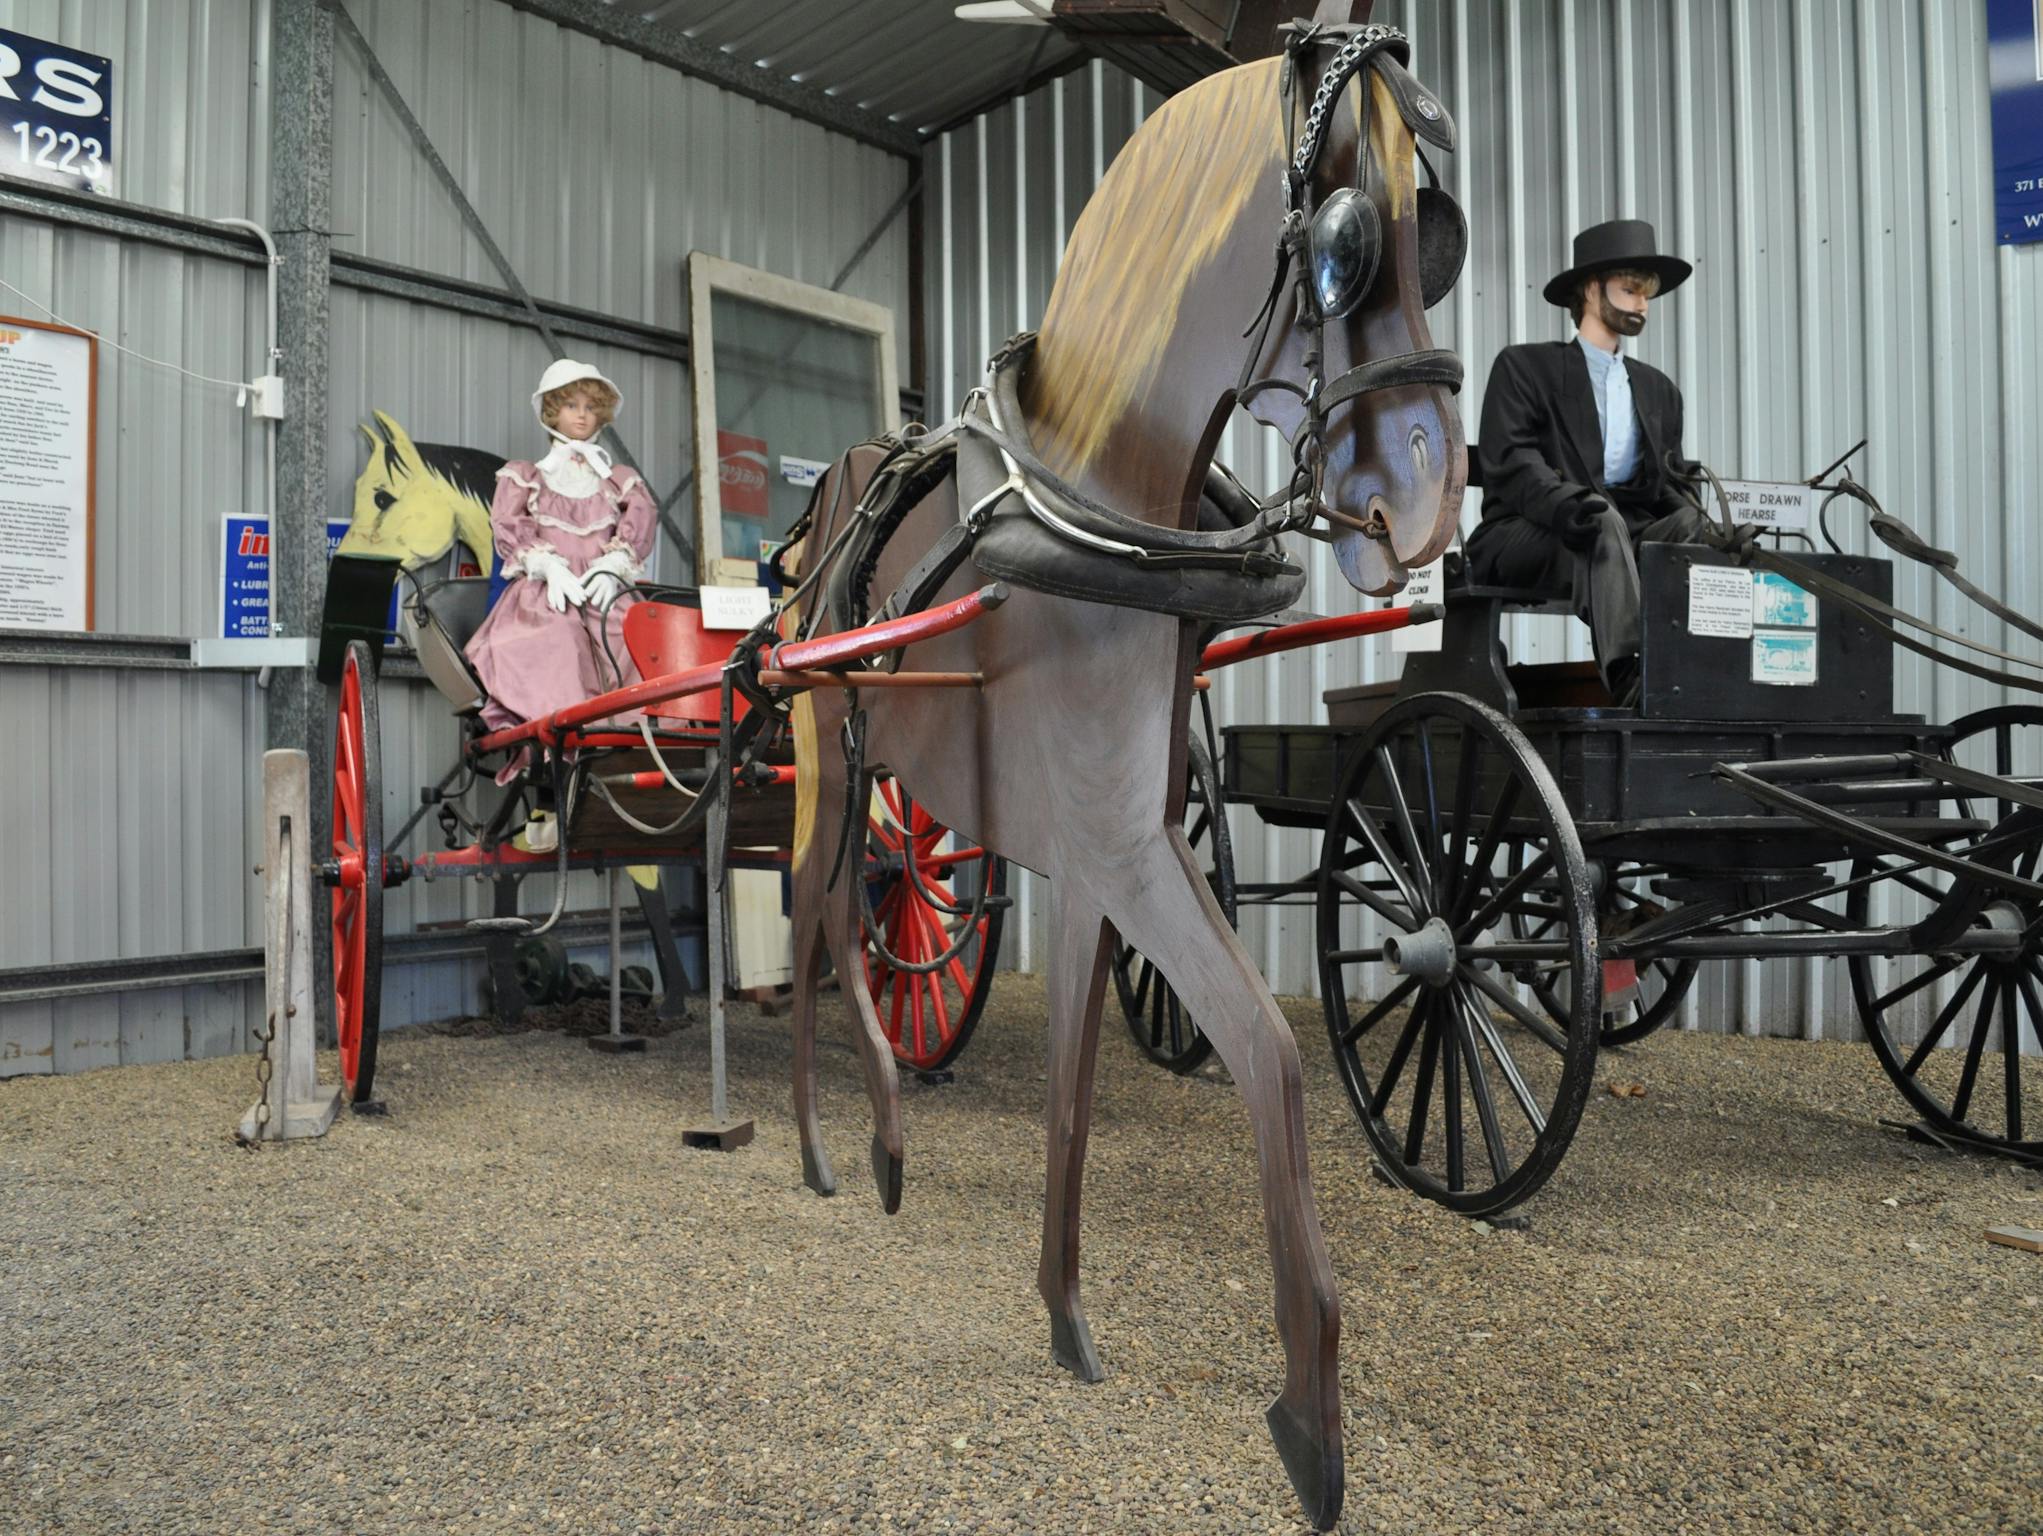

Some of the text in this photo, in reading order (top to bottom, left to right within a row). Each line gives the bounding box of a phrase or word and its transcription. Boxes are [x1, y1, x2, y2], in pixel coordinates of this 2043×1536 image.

[12, 121, 103, 180] 1223
[2015, 180, 2034, 193] 371
[1717, 490, 1802, 507] ORSE DRAWN
[1738, 508, 1776, 521] HEARSE
